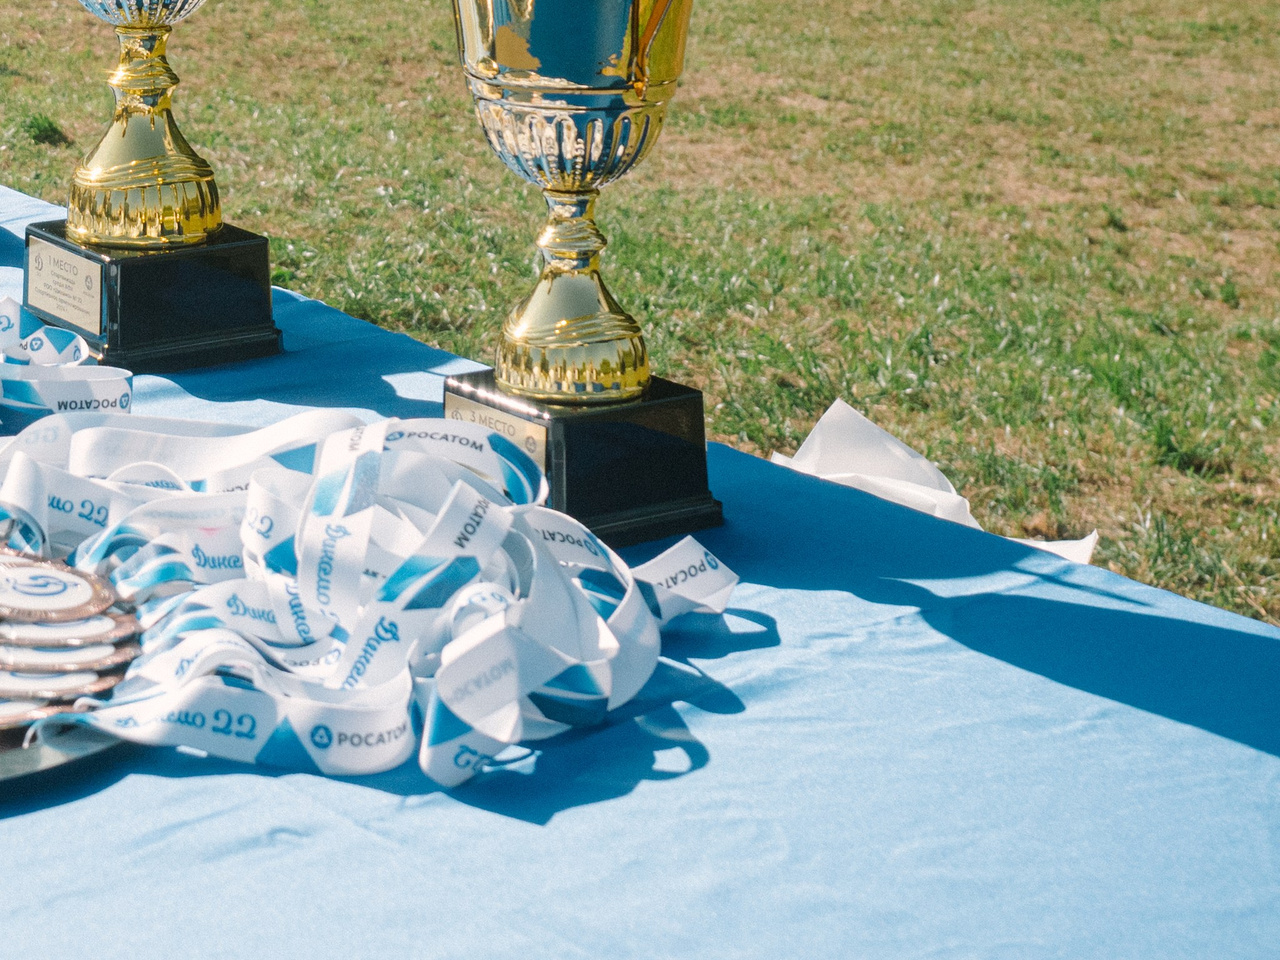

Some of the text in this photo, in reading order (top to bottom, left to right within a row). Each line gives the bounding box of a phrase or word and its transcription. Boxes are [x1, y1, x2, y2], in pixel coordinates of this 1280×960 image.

[58, 398, 117, 411] РОСАТОМ
[469, 411, 476, 423] 3
[480, 414, 516, 437] МЕСТО
[407, 431, 484, 452] РОСАТОМ
[78, 499, 109, 528] 22
[317, 524, 353, 606] Динамо
[211, 708, 257, 740] 22
